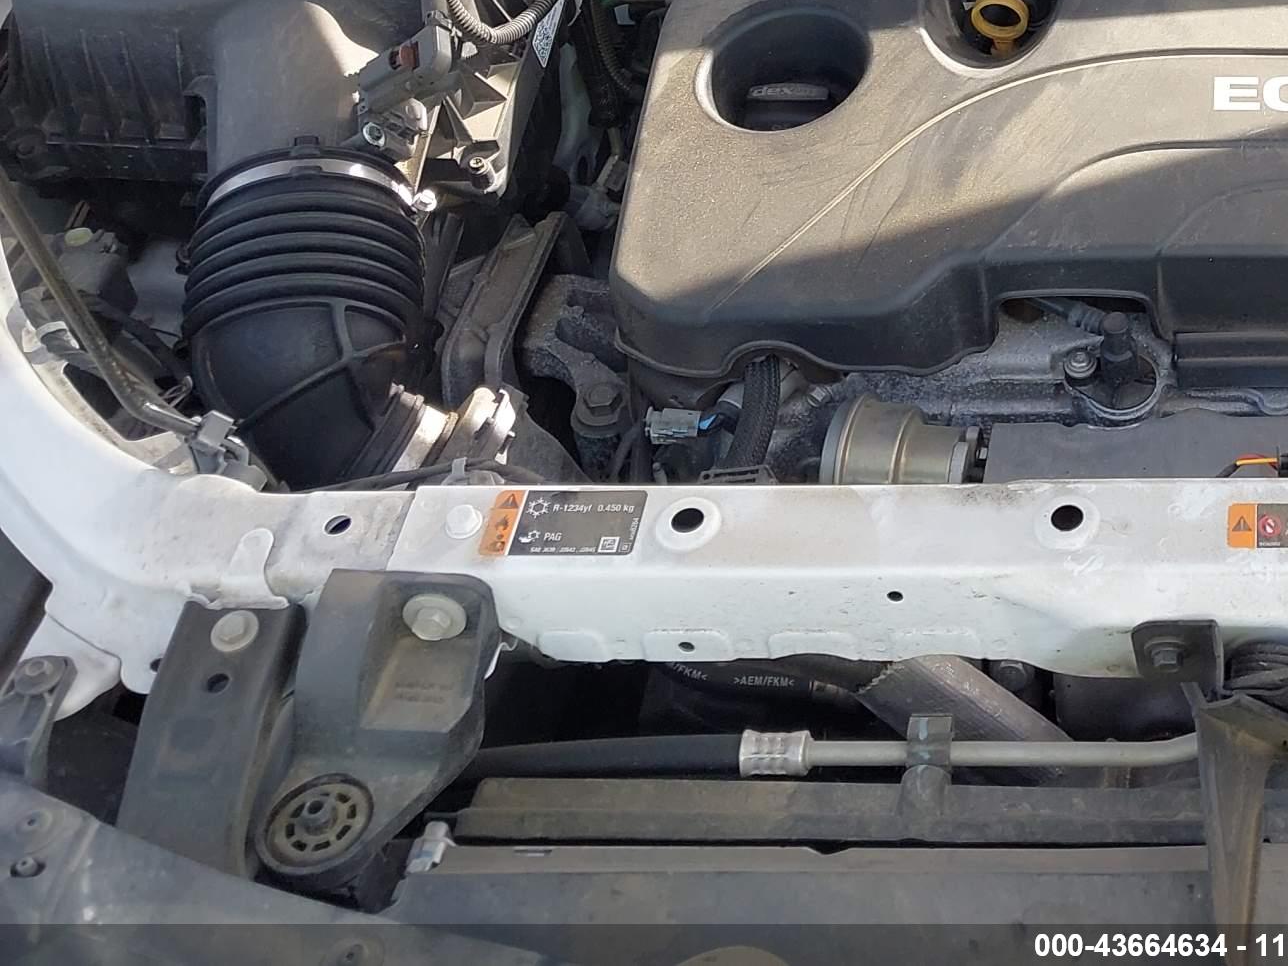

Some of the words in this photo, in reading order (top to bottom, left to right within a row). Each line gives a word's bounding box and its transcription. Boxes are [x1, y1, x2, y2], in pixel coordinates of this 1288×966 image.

[552, 504, 592, 514] R-1234yf
[597, 504, 621, 512] 0.450
[622, 504, 635, 513] kg
[543, 532, 562, 541] PAG
